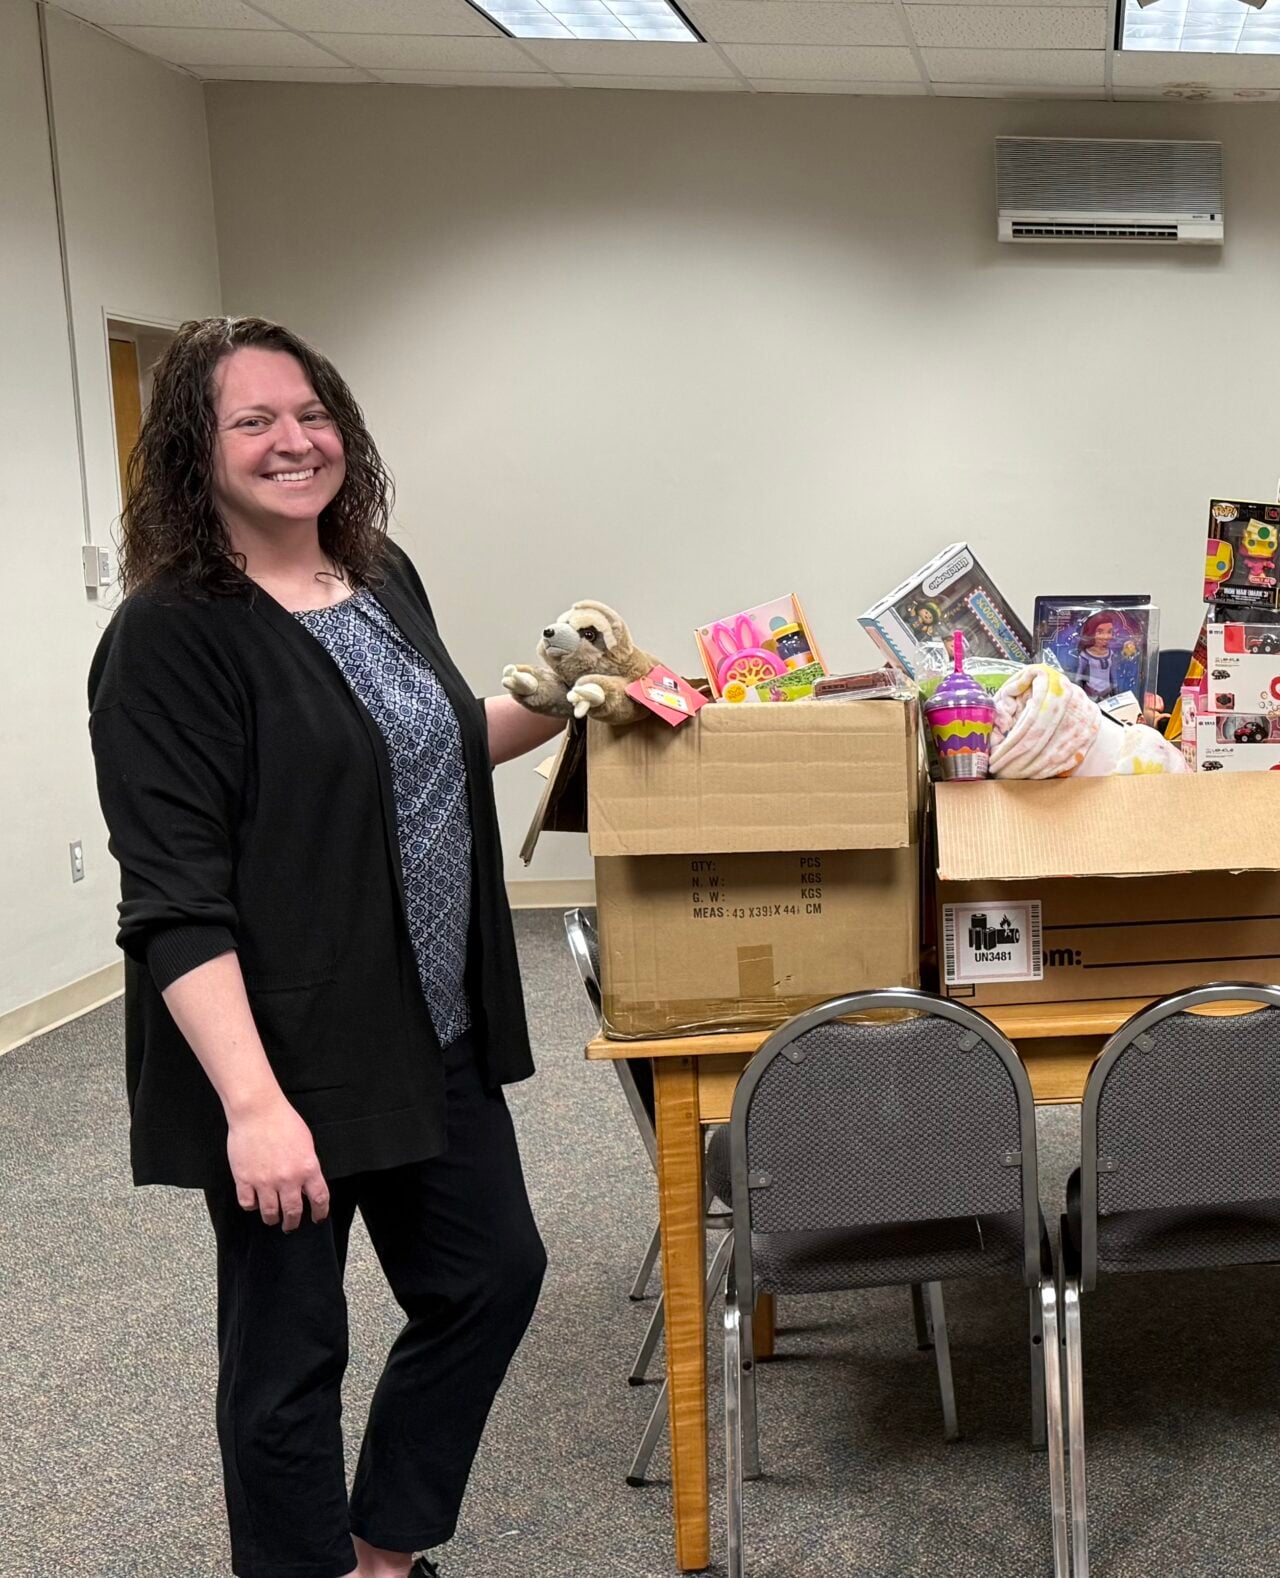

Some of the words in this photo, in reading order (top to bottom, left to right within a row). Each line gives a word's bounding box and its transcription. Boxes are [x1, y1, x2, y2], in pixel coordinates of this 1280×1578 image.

[691, 860, 716, 872] QTY:
[799, 857, 821, 869] PCS
[801, 872, 822, 884] KGS
[801, 888, 822, 900] KGS
[693, 907, 730, 919] MEAS:
[805, 903, 822, 915] CM
[974, 951, 1012, 962] UN3481
